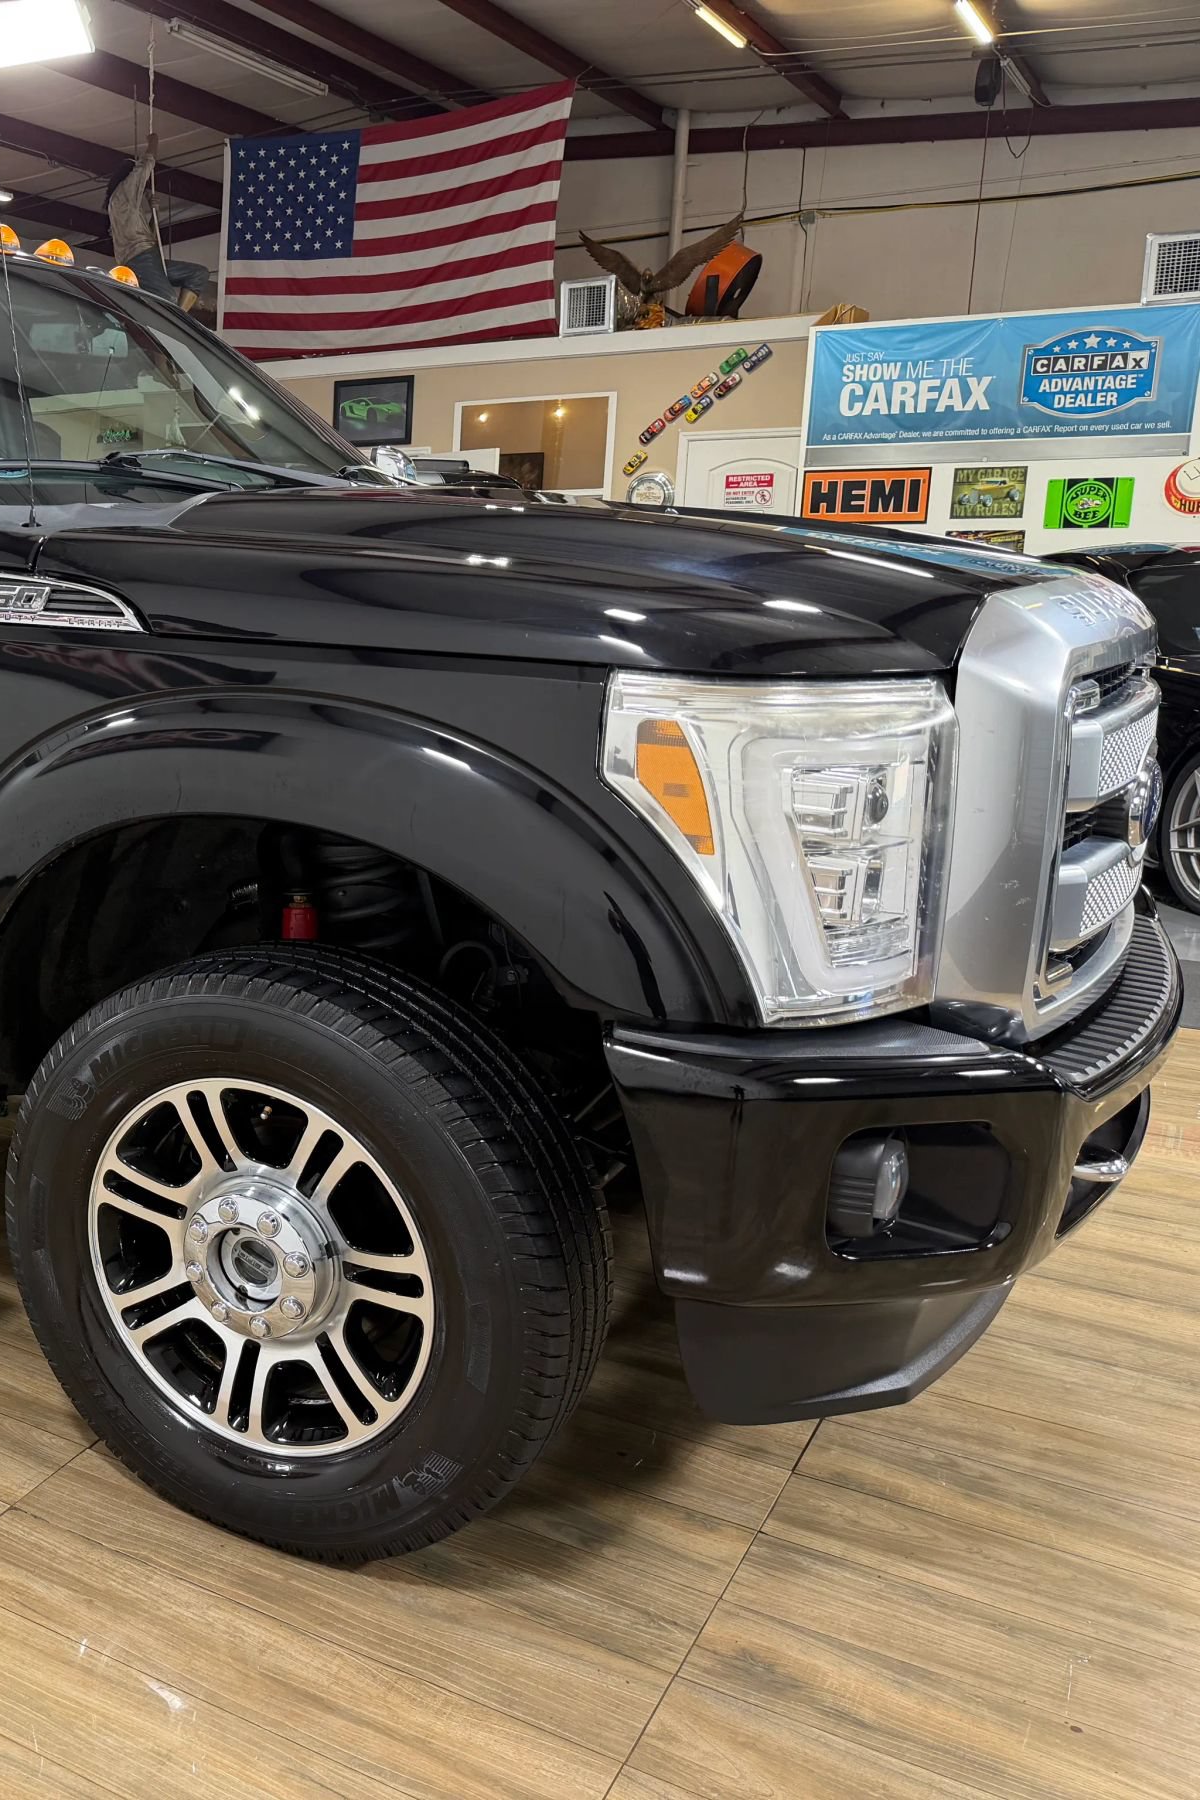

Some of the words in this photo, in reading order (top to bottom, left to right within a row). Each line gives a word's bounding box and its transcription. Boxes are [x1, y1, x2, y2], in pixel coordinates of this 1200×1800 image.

[843, 352, 866, 363] JUST
[867, 351, 885, 361] SAY
[1035, 353, 1145, 372] CARFAX
[842, 362, 901, 382] SHOW
[906, 360, 934, 379] ME
[939, 357, 975, 377] THE
[840, 376, 993, 416] CARFAX
[1054, 392, 1118, 408] DEALER
[838, 432, 863, 440] CARFAX
[944, 428, 979, 437] committed
[981, 427, 988, 435] to
[989, 427, 1015, 436] offering
[1054, 424, 1077, 434] Report
[1090, 424, 1109, 432] every
[1111, 422, 1128, 430] used
[1157, 421, 1172, 429] sell.
[956, 470, 975, 482] MY
[978, 468, 1025, 480] GARAGE
[808, 478, 922, 514] HEMI
[1070, 486, 1107, 501] SUPER
[953, 504, 974, 516] MY
[977, 502, 1021, 516] RULES!
[1073, 510, 1100, 520] BEE
[68, 618, 123, 628] LARIAT
